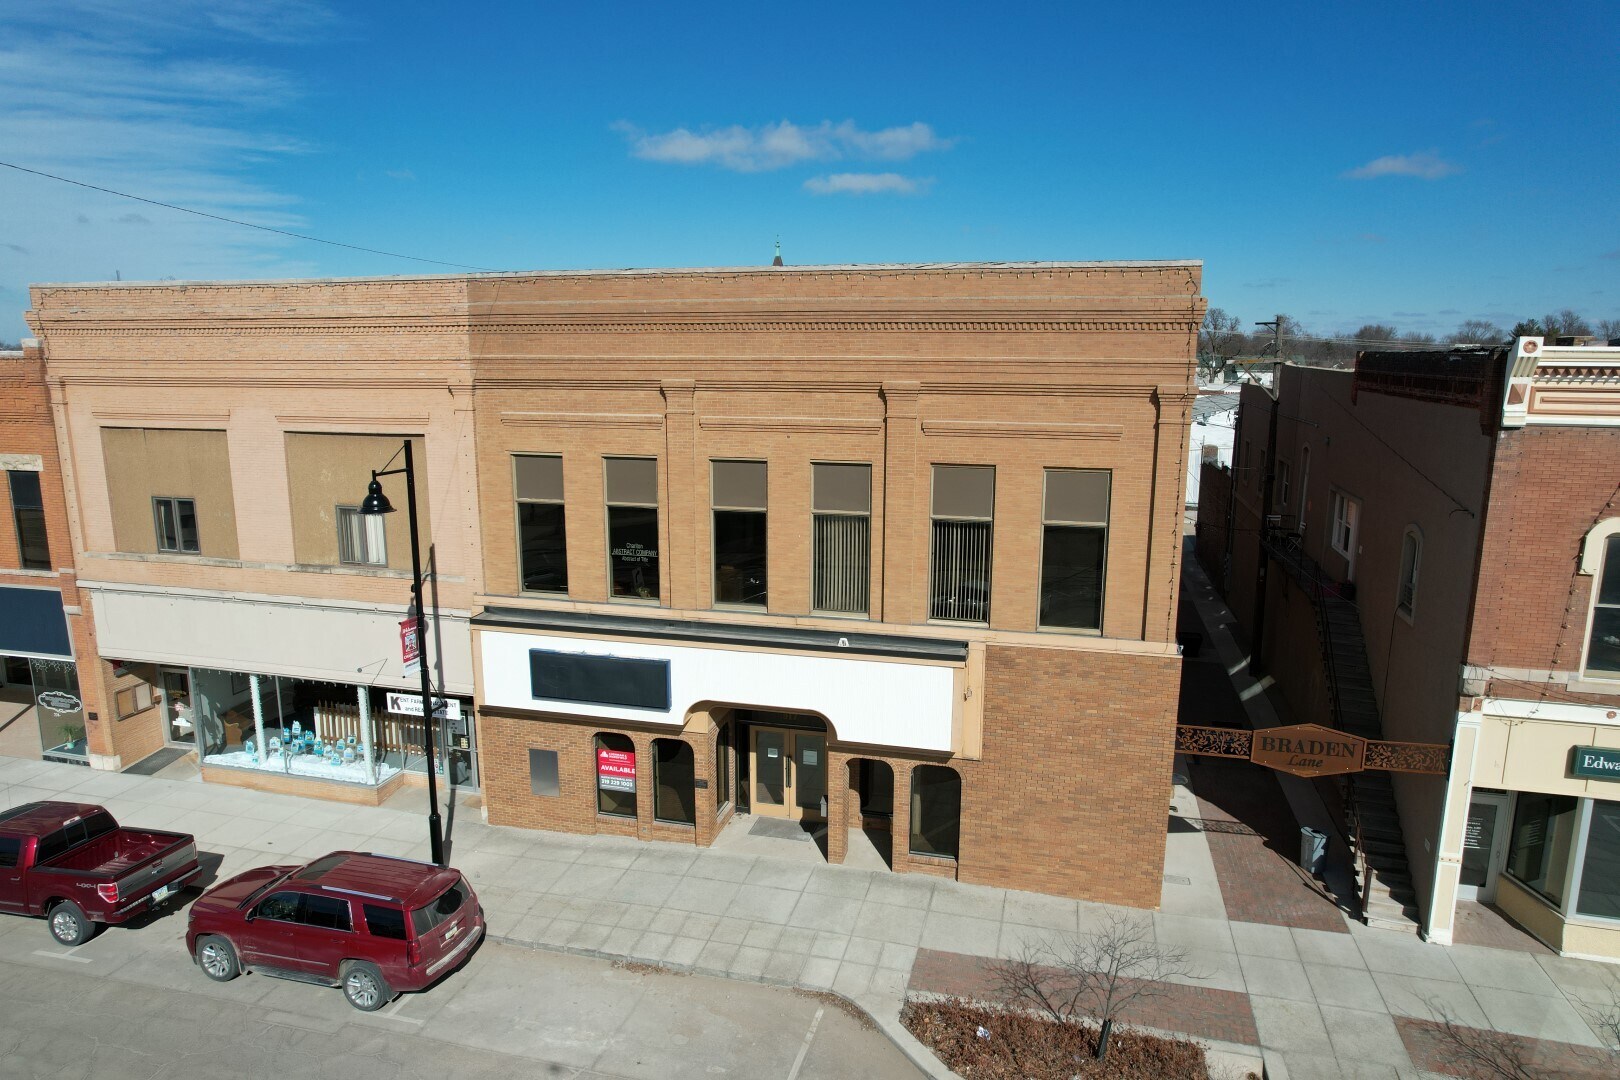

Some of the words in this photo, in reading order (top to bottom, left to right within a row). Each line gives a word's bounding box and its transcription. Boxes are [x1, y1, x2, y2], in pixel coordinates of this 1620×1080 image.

[636, 549, 658, 557] COMPANY
[1258, 736, 1358, 759] BRADEN
[1287, 755, 1323, 768] Lane
[601, 765, 635, 774] AVAILABLE
